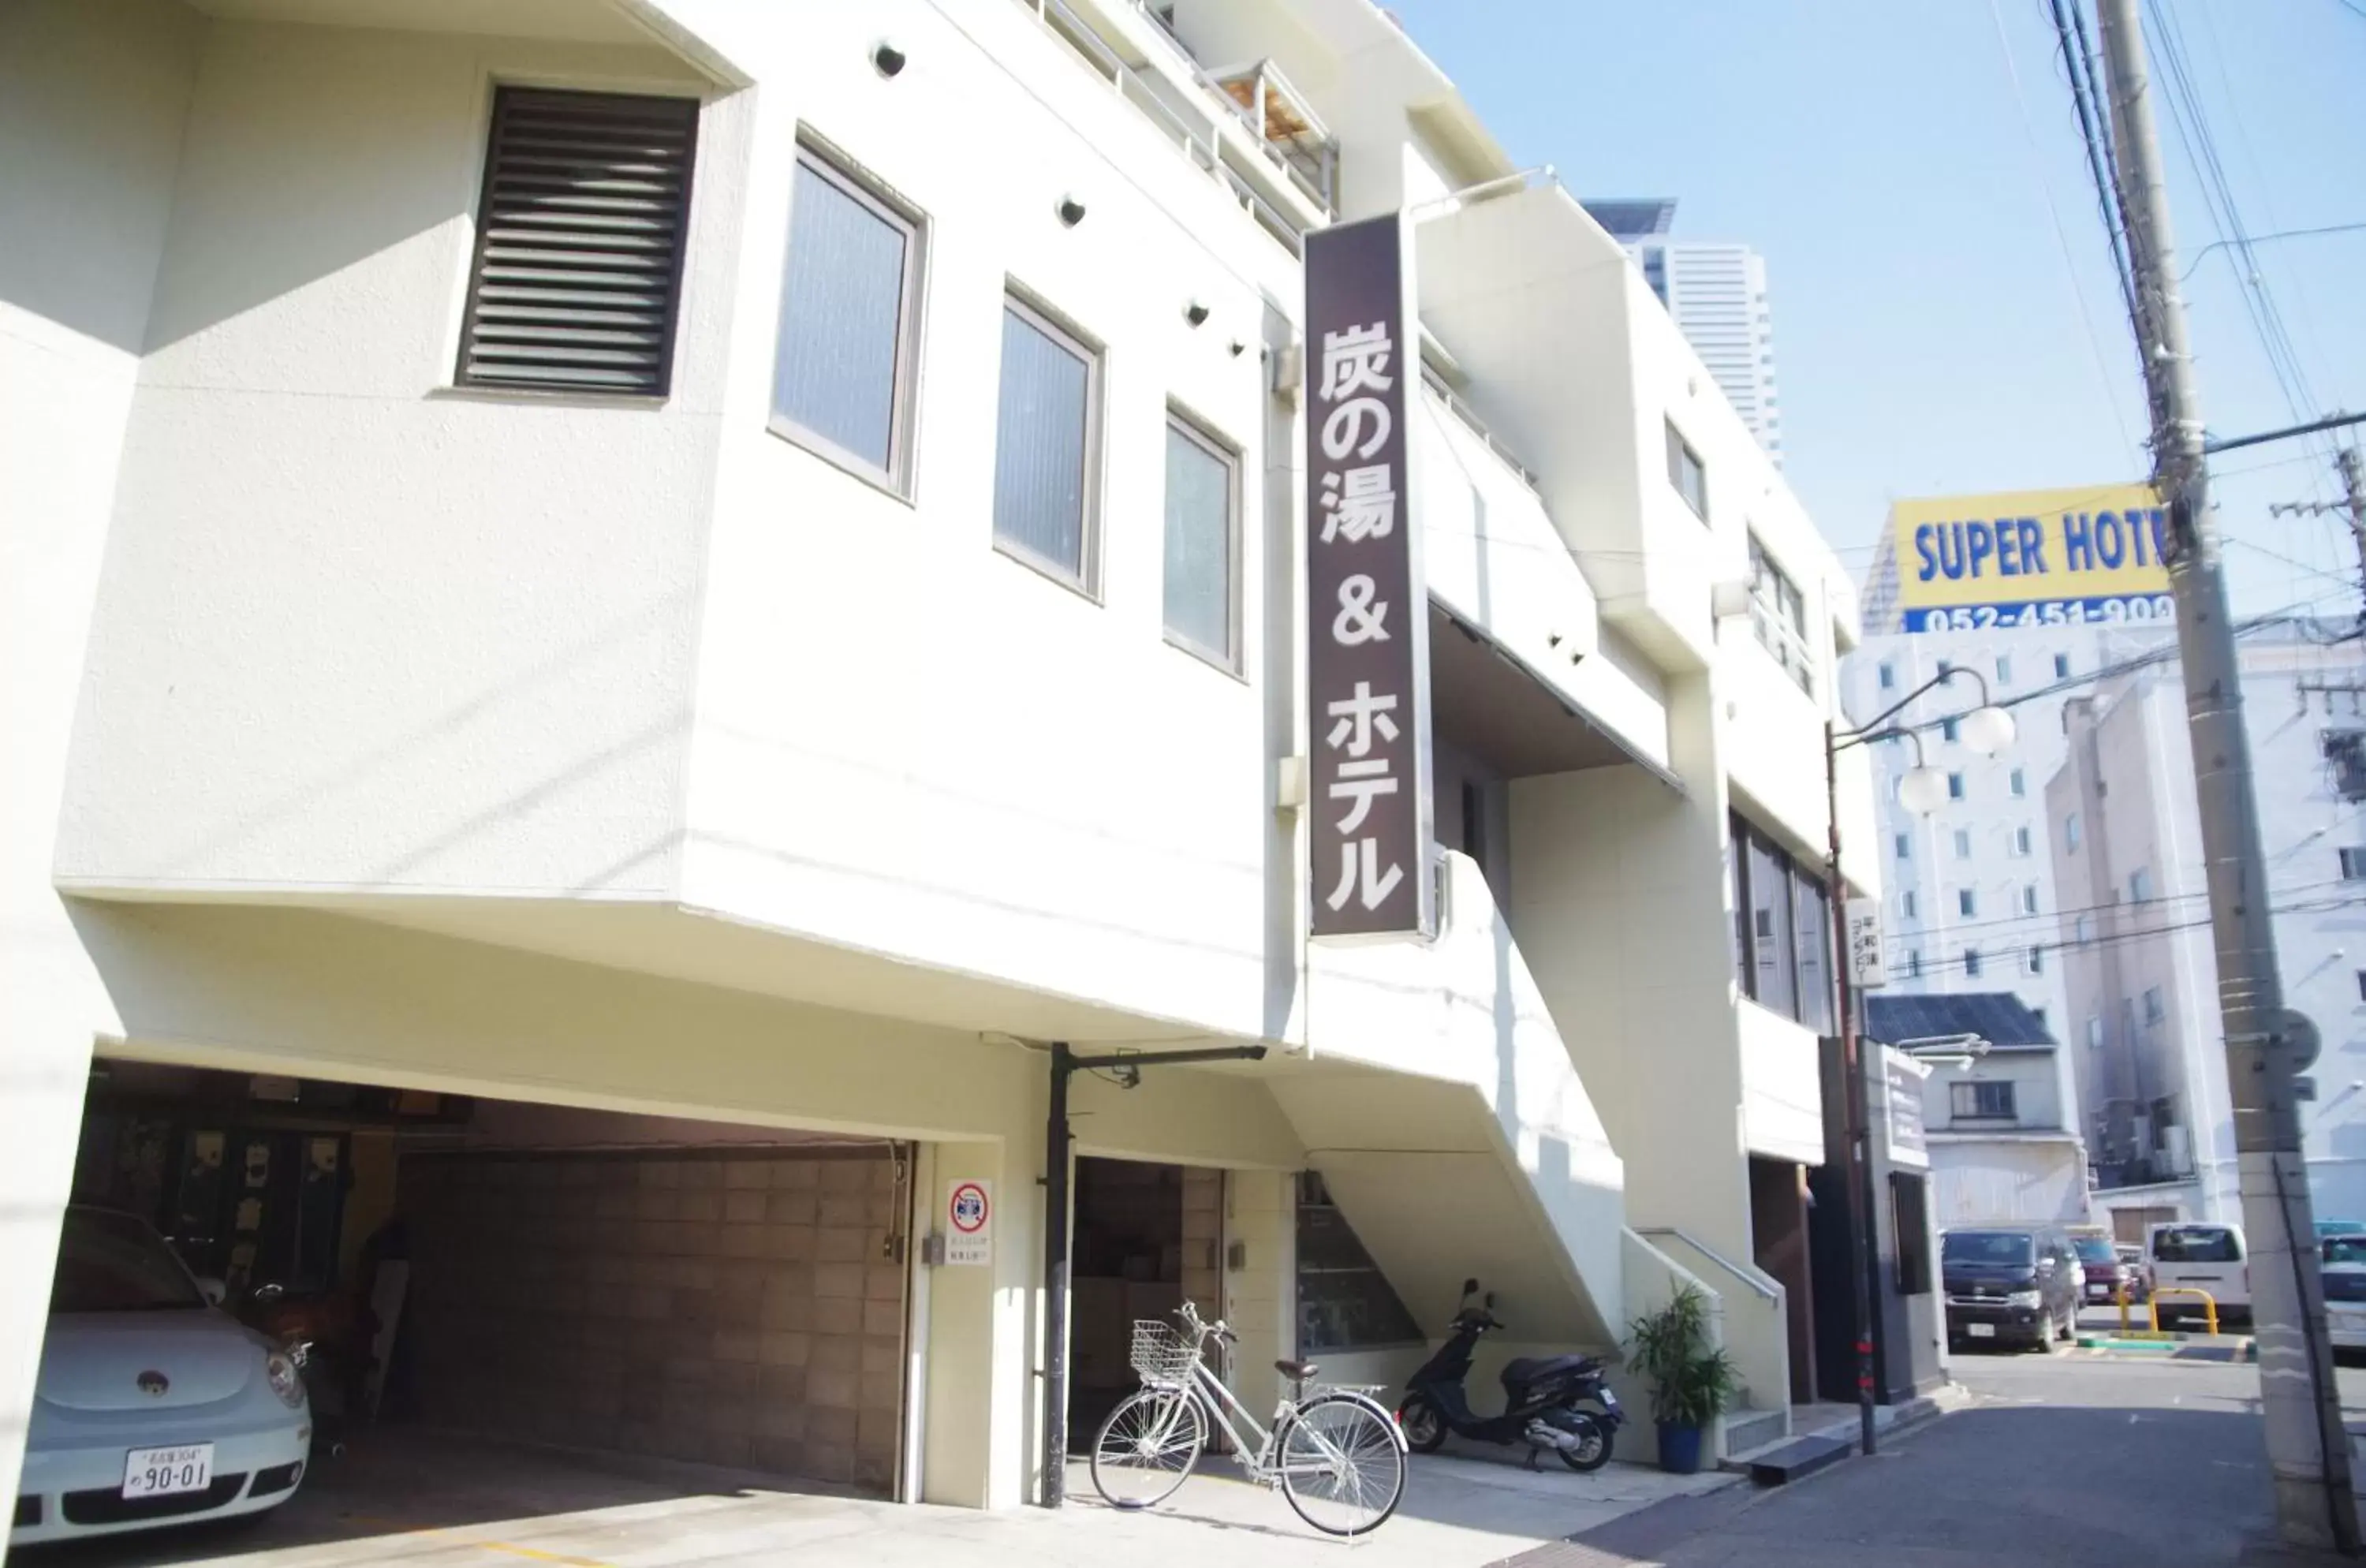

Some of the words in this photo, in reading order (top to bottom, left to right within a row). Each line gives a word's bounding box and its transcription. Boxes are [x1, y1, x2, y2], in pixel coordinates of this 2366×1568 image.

[1319, 320, 1396, 545] 炭の湯
[1915, 517, 2050, 582] SUPER
[1332, 573, 1391, 646] &
[1326, 681, 1404, 912] ホテル
[144, 1462, 204, 1491] 90-01
